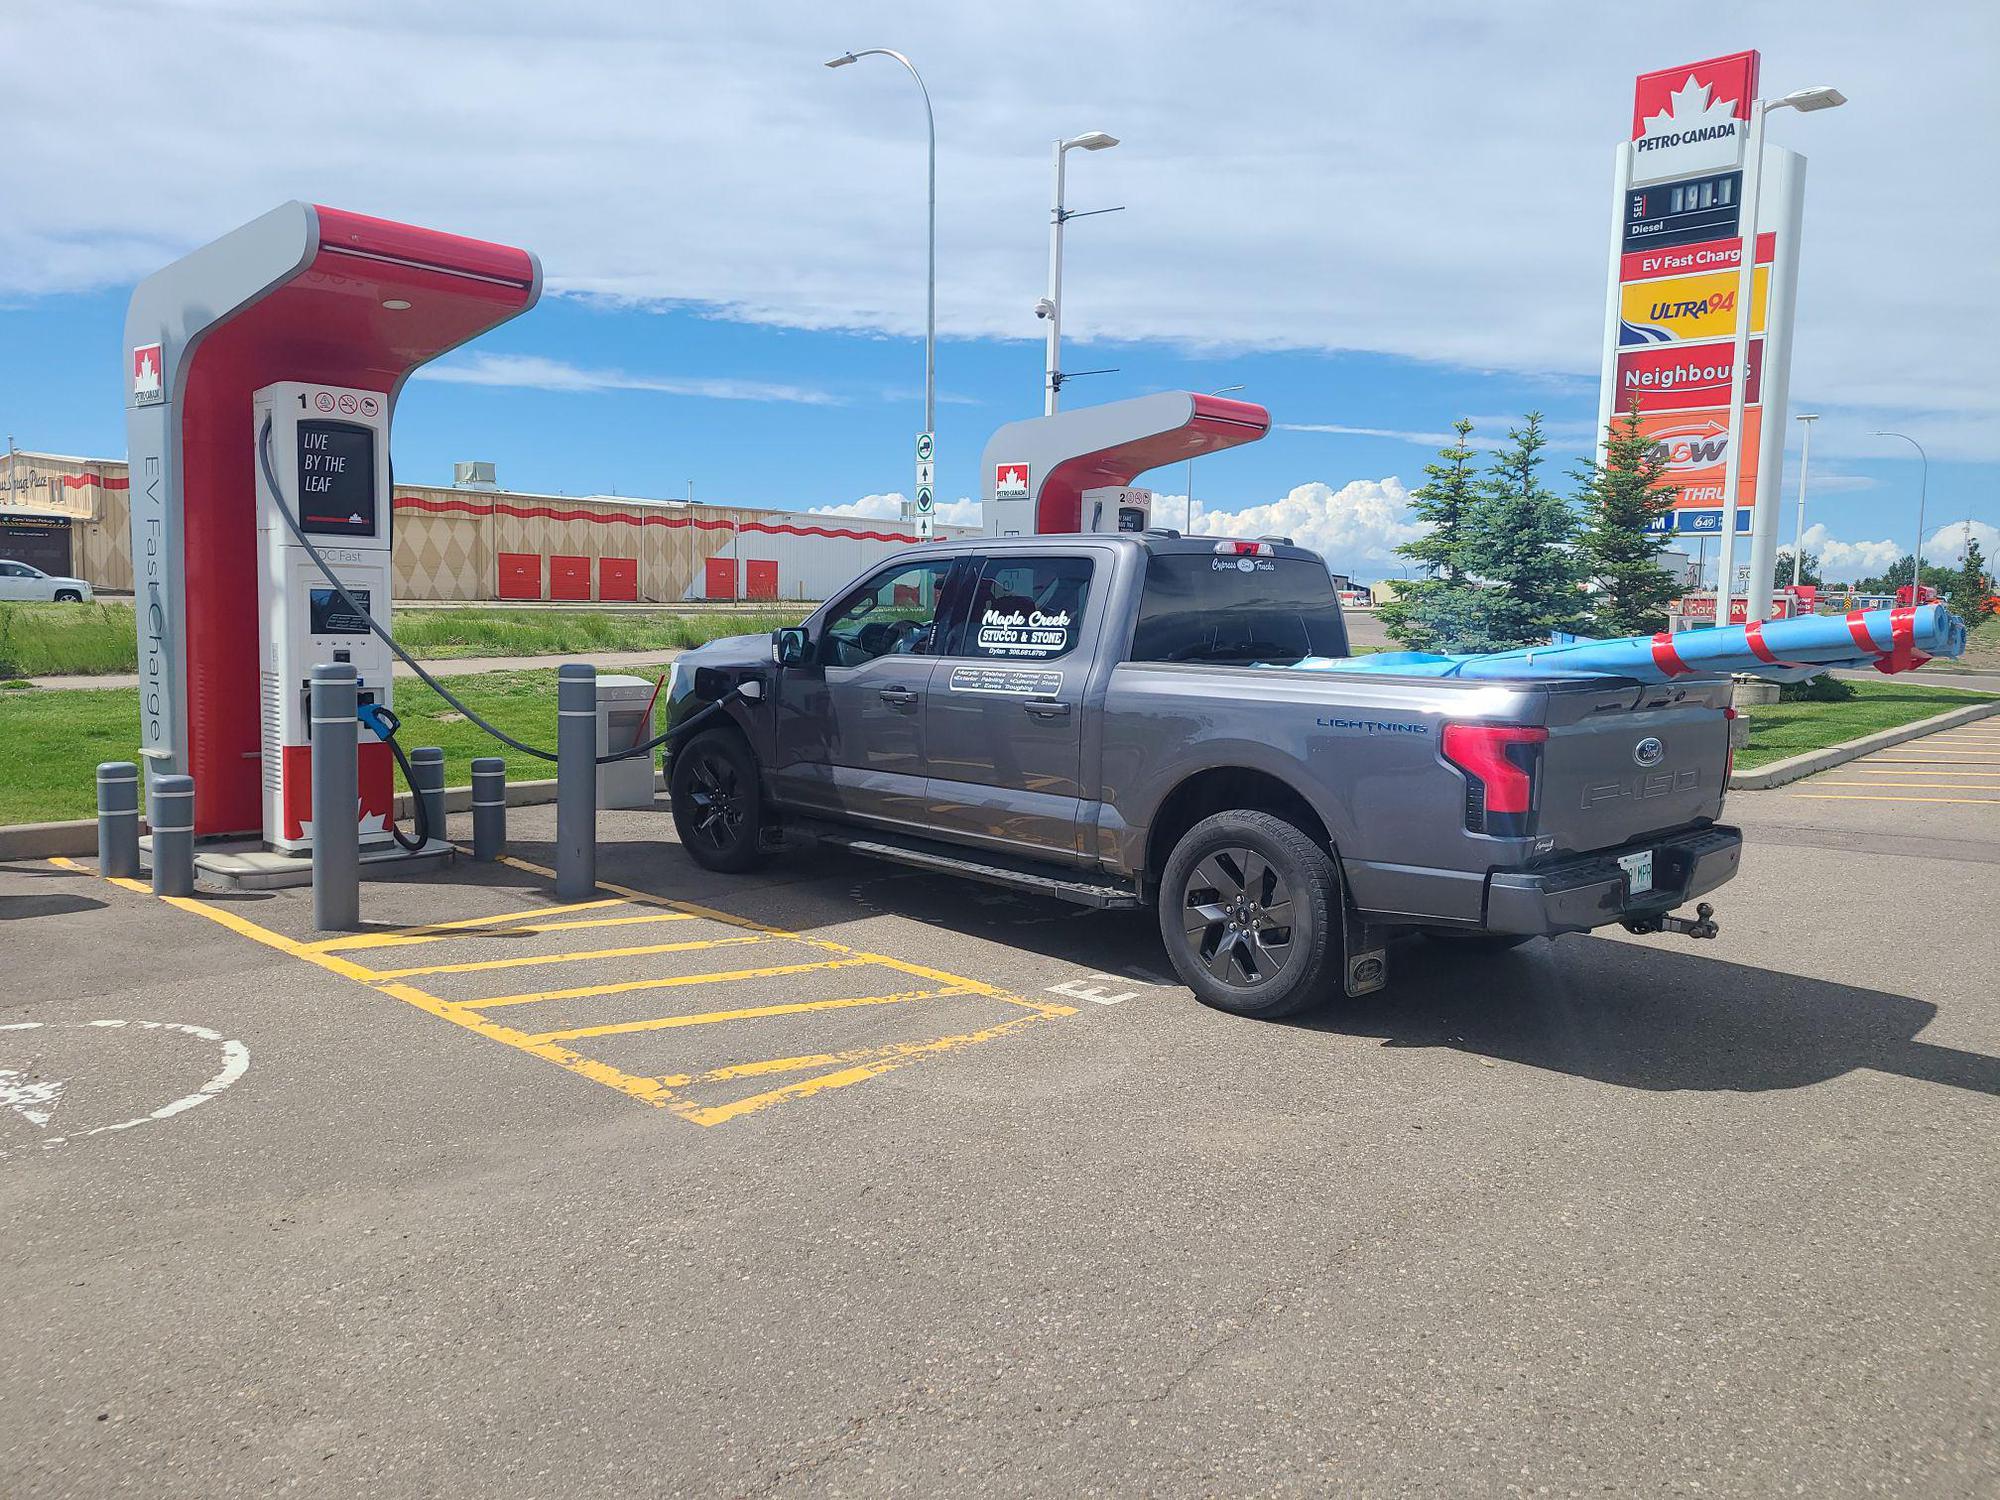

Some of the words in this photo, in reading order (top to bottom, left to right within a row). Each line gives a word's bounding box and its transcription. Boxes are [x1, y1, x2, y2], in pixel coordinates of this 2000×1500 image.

[1634, 195, 1643, 218] SELF
[1632, 221, 1663, 234] Diesel
[1642, 258, 1661, 271] EV
[1665, 255, 1693, 268] Fast
[1695, 249, 1742, 264] Charg
[1625, 364, 1751, 387] Neighbous
[298, 394, 307, 408] 1
[304, 432, 329, 451] LIVE
[1646, 440, 1728, 463] A&W
[304, 454, 319, 471] BY
[324, 456, 346, 473] THE
[145, 457, 160, 504] EV
[305, 475, 332, 493] LEAF
[1120, 493, 1126, 503] 2
[147, 519, 160, 592] Fast
[340, 551, 361, 561] Fast
[982, 610, 1025, 631] Maple
[1028, 610, 1070, 627] Creek
[982, 629, 1017, 642] STUCCO
[1021, 632, 1028, 642] &
[1031, 632, 1062, 644] STONE
[147, 603, 162, 741] Charge
[1316, 718, 1429, 734] LIGHTNING
